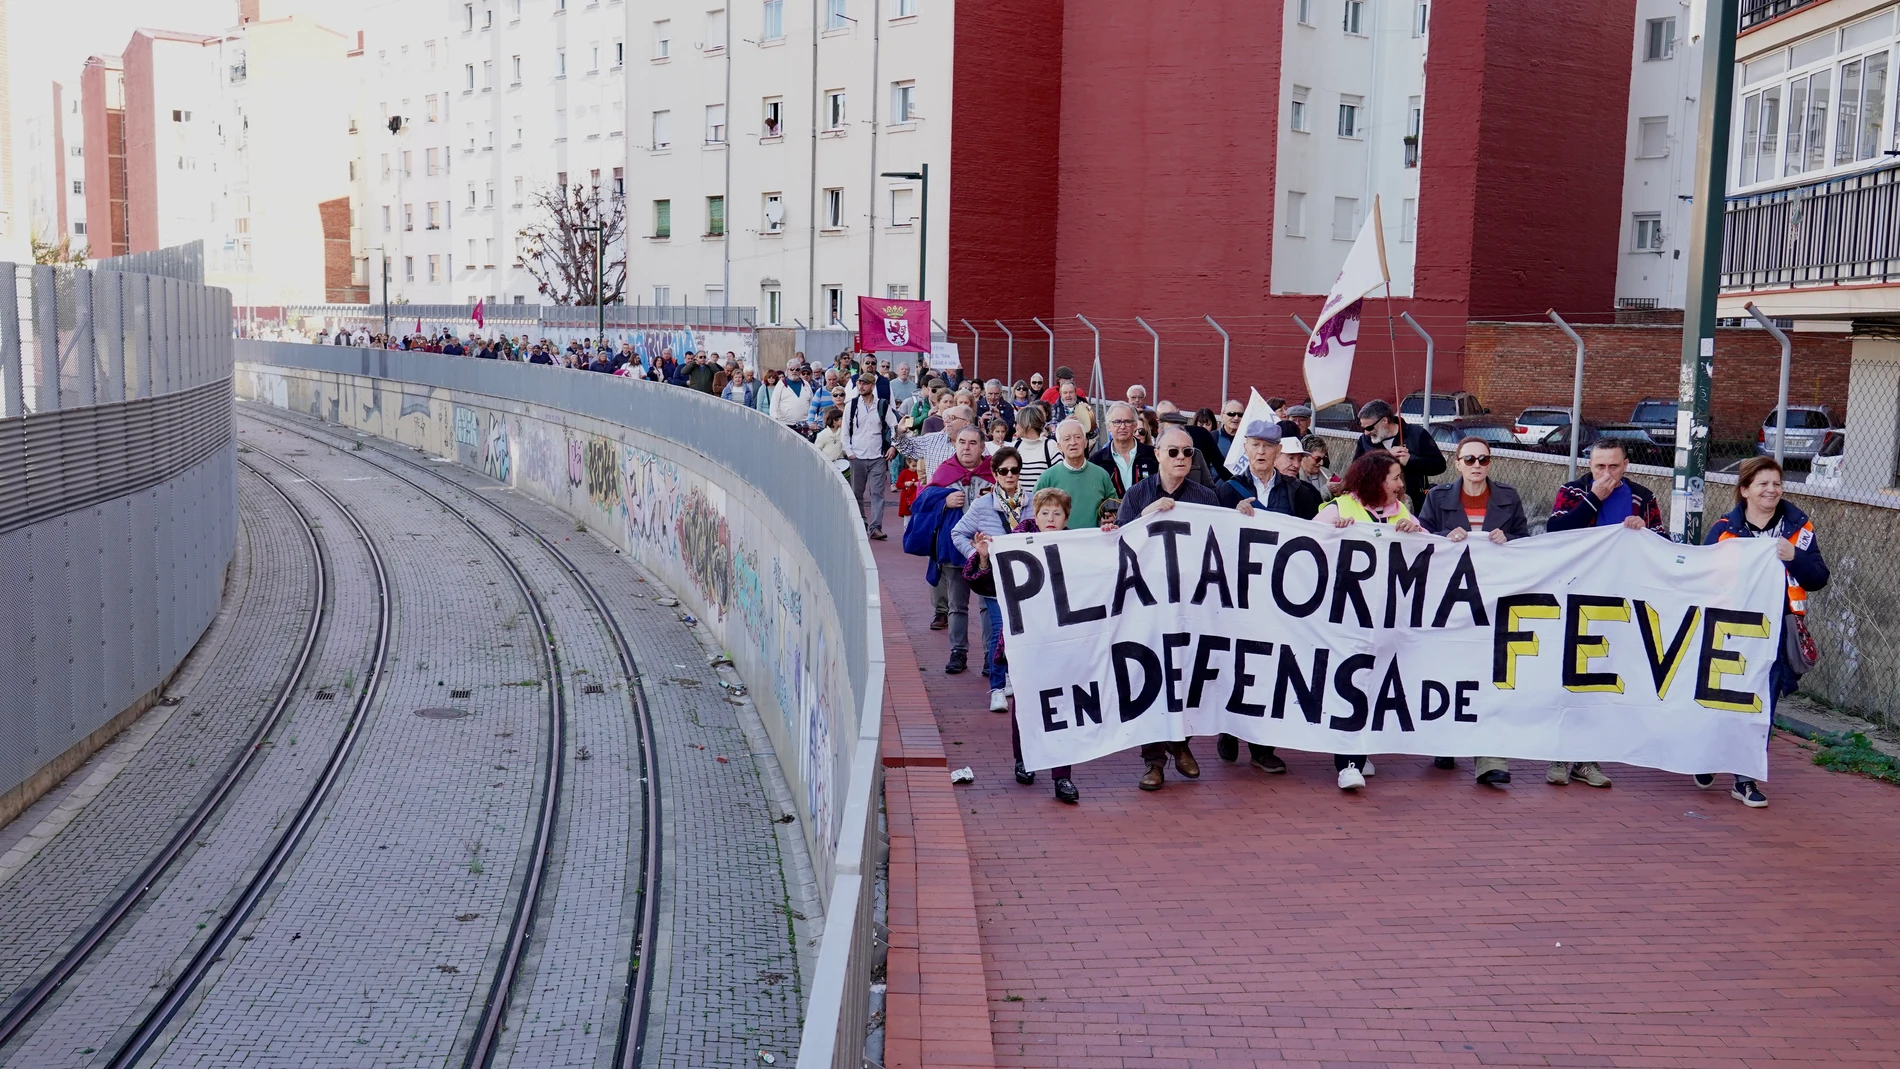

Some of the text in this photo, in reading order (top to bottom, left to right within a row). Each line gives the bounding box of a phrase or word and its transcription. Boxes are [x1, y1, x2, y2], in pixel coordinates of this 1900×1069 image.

[995, 521, 1490, 636] PLATAFORMA
[1040, 593, 1771, 733] EN DEFENSA DE FEVE
